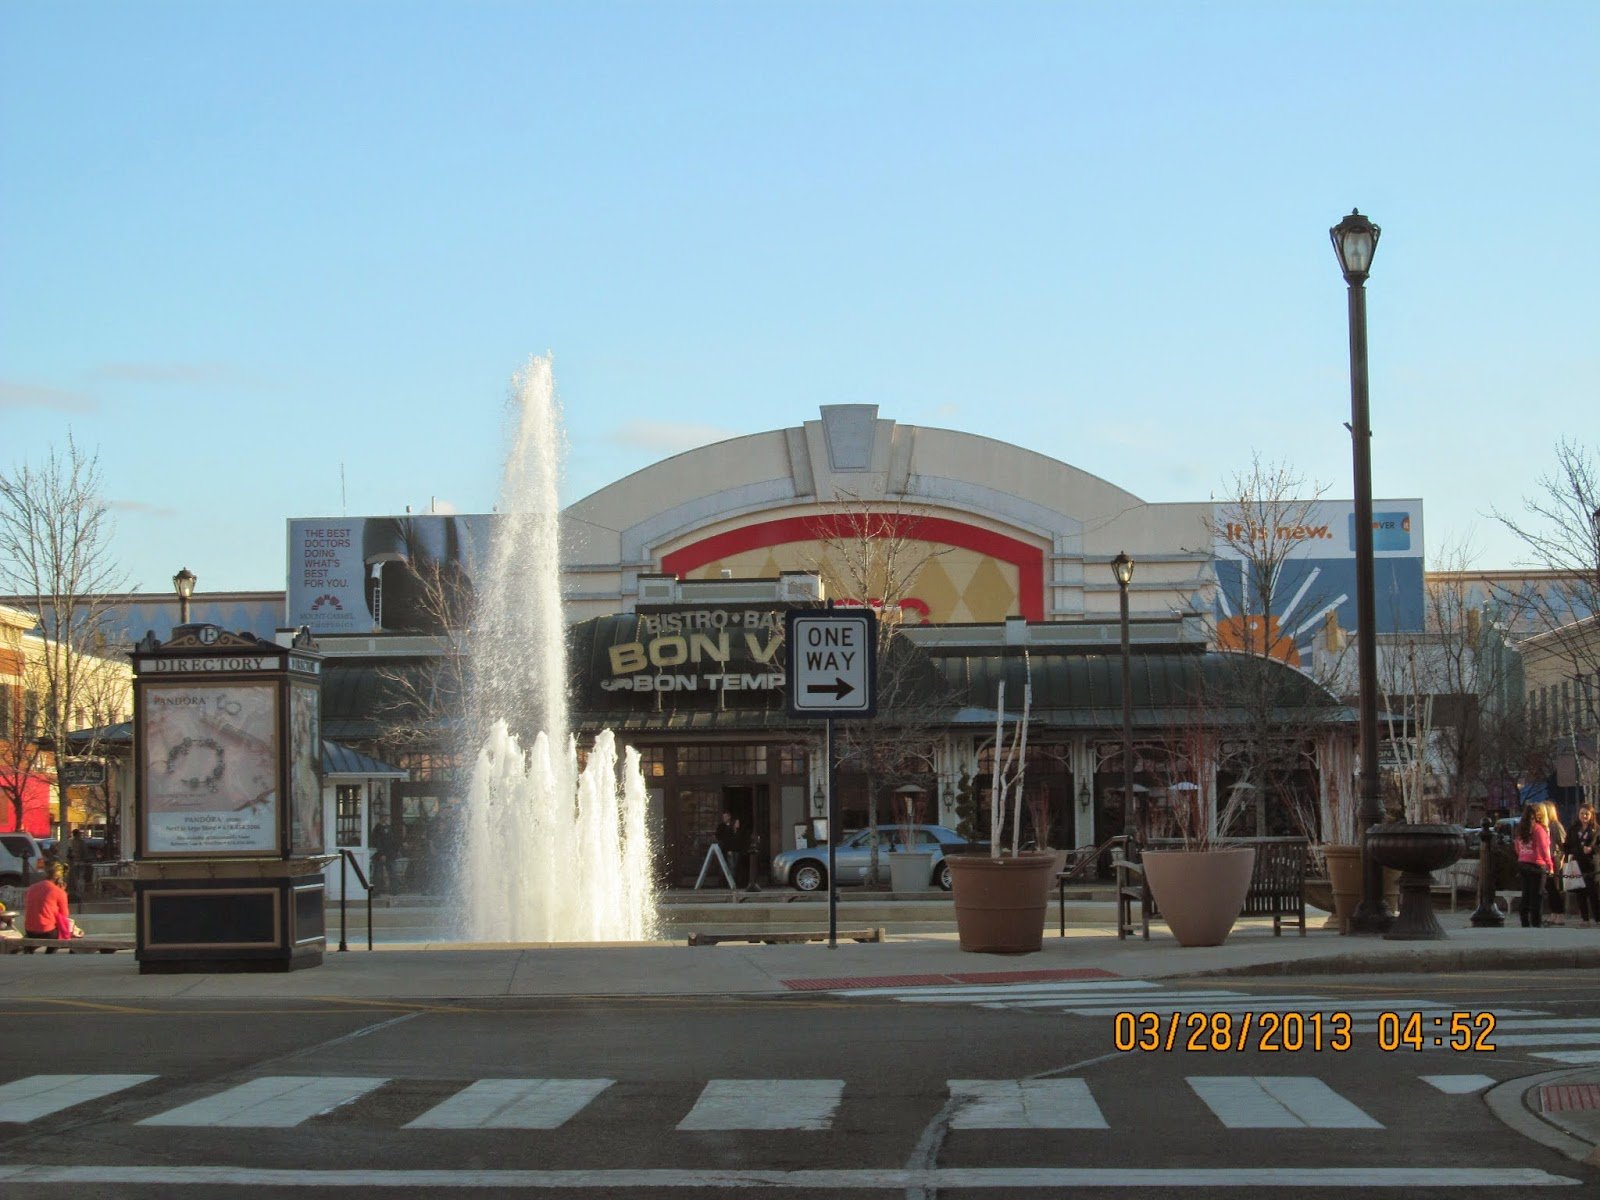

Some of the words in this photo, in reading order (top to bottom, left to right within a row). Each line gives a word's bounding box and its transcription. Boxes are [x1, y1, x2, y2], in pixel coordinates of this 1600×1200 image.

[304, 529, 325, 538] THE
[327, 529, 351, 538] BEST
[1227, 523, 1242, 540] It
[1276, 524, 1333, 540] new.
[304, 539, 351, 548] DOCTORS
[304, 549, 335, 558] DOING
[304, 559, 341, 568] WHAT'S
[304, 569, 329, 578] BEST
[304, 579, 324, 588] FOR
[326, 579, 349, 588] YOU.
[645, 609, 729, 635] BISTRO
[808, 627, 854, 647] ONE
[608, 632, 731, 676] BON
[743, 631, 786, 664] V
[155, 657, 264, 672] DIRECTORY
[806, 651, 856, 671] WAY
[632, 674, 698, 692] BON
[703, 673, 786, 691] TEMP
[153, 694, 207, 705] PANDORA
